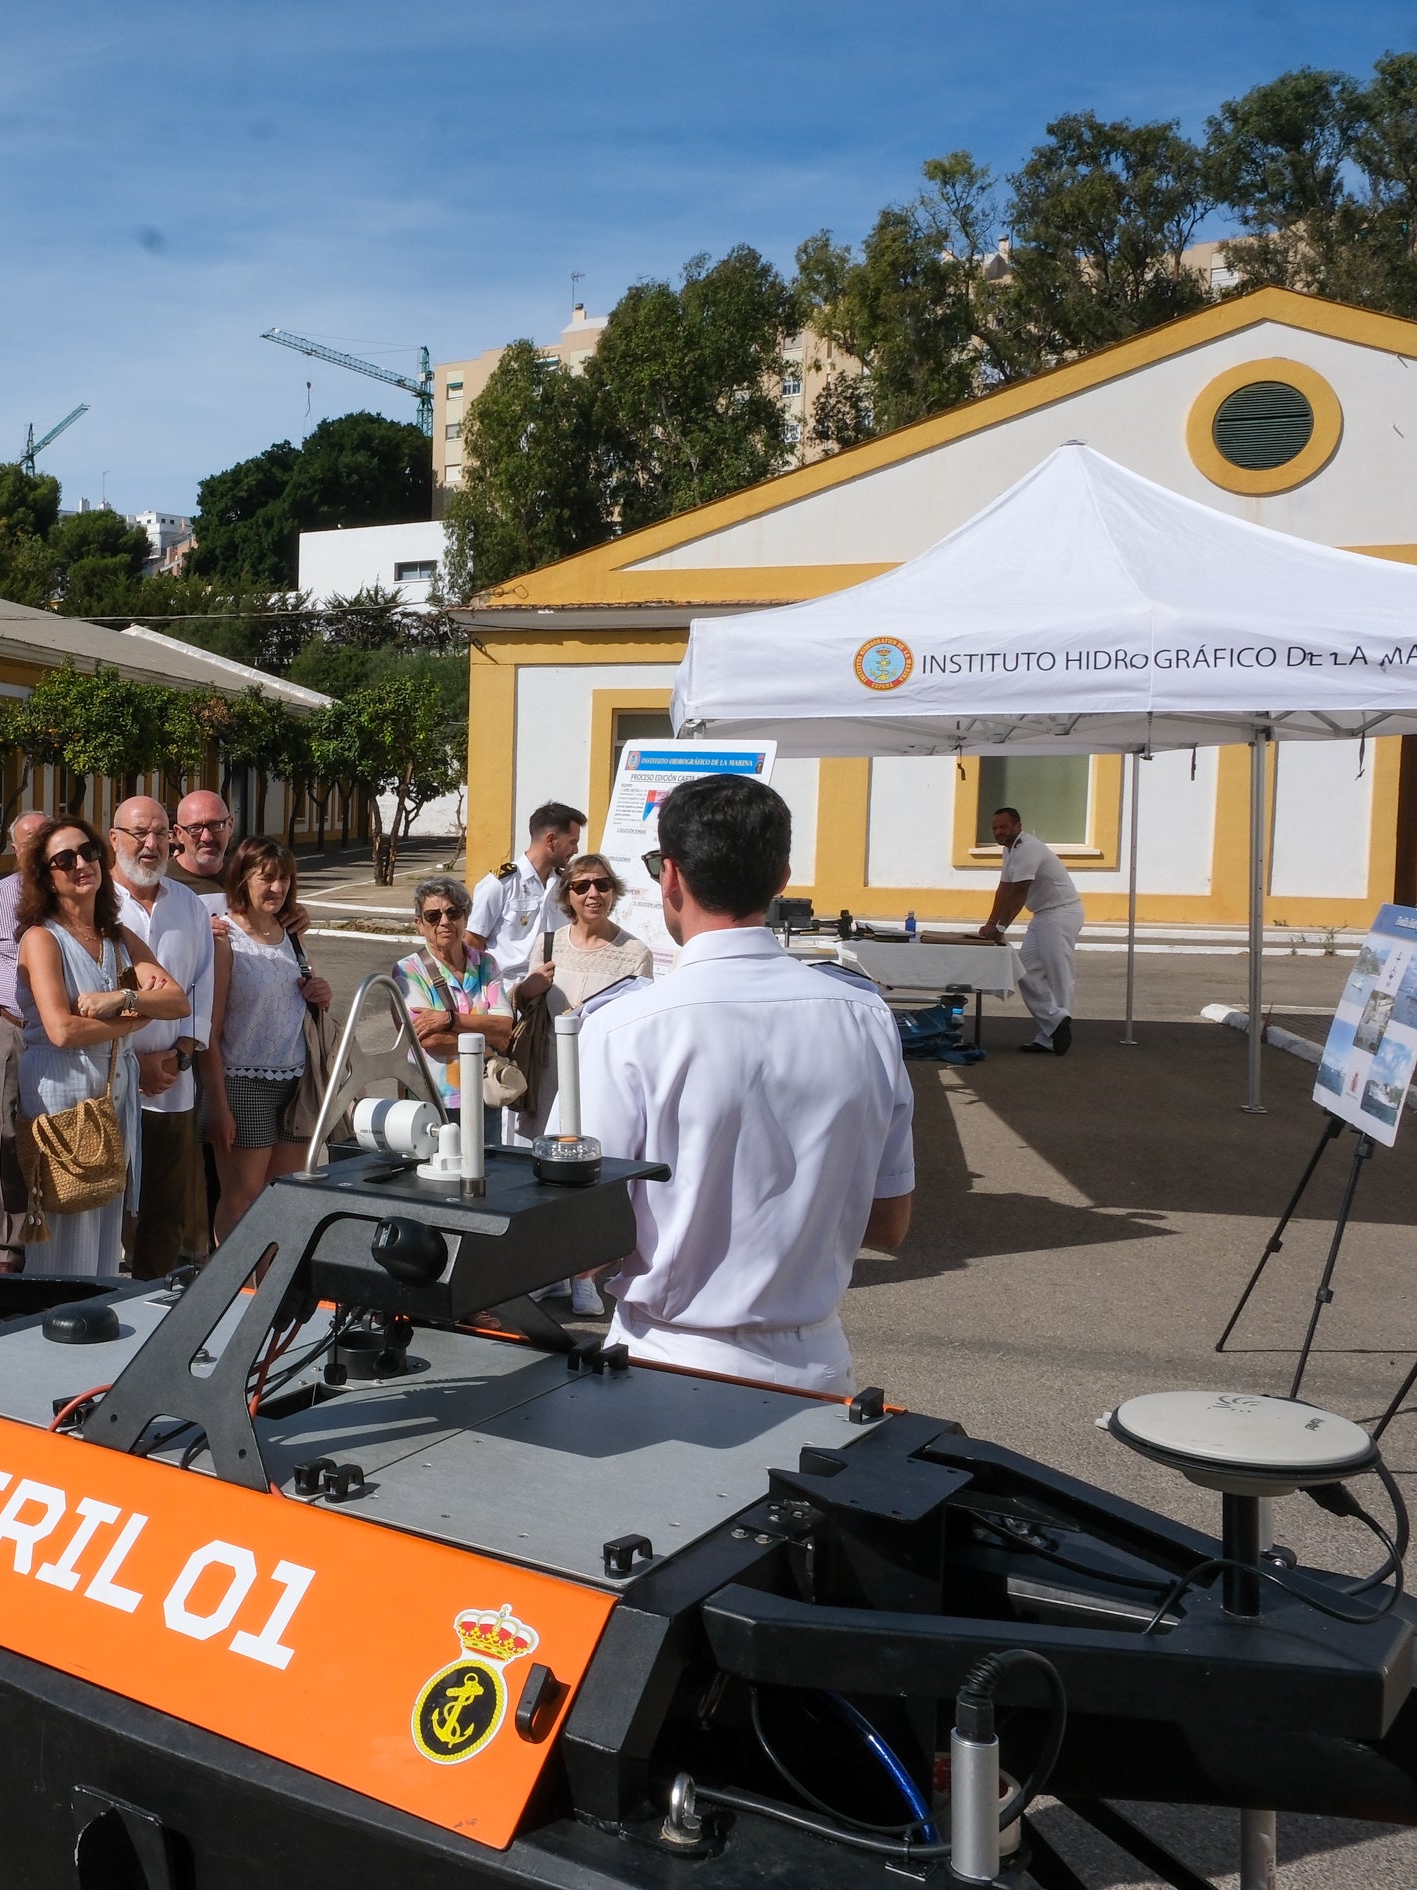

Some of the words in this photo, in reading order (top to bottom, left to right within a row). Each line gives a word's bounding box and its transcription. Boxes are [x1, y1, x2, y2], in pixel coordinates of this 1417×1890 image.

[922, 651, 1056, 674] INSTITUTO
[1065, 644, 1277, 670] HIDROGRÁFICO
[1287, 646, 1323, 667] DE
[1330, 645, 1368, 666] LA
[711, 758, 719, 766] DE
[729, 759, 753, 767] MARINA
[655, 773, 677, 782] EDICIÓN
[163, 1539, 316, 1671] 01
